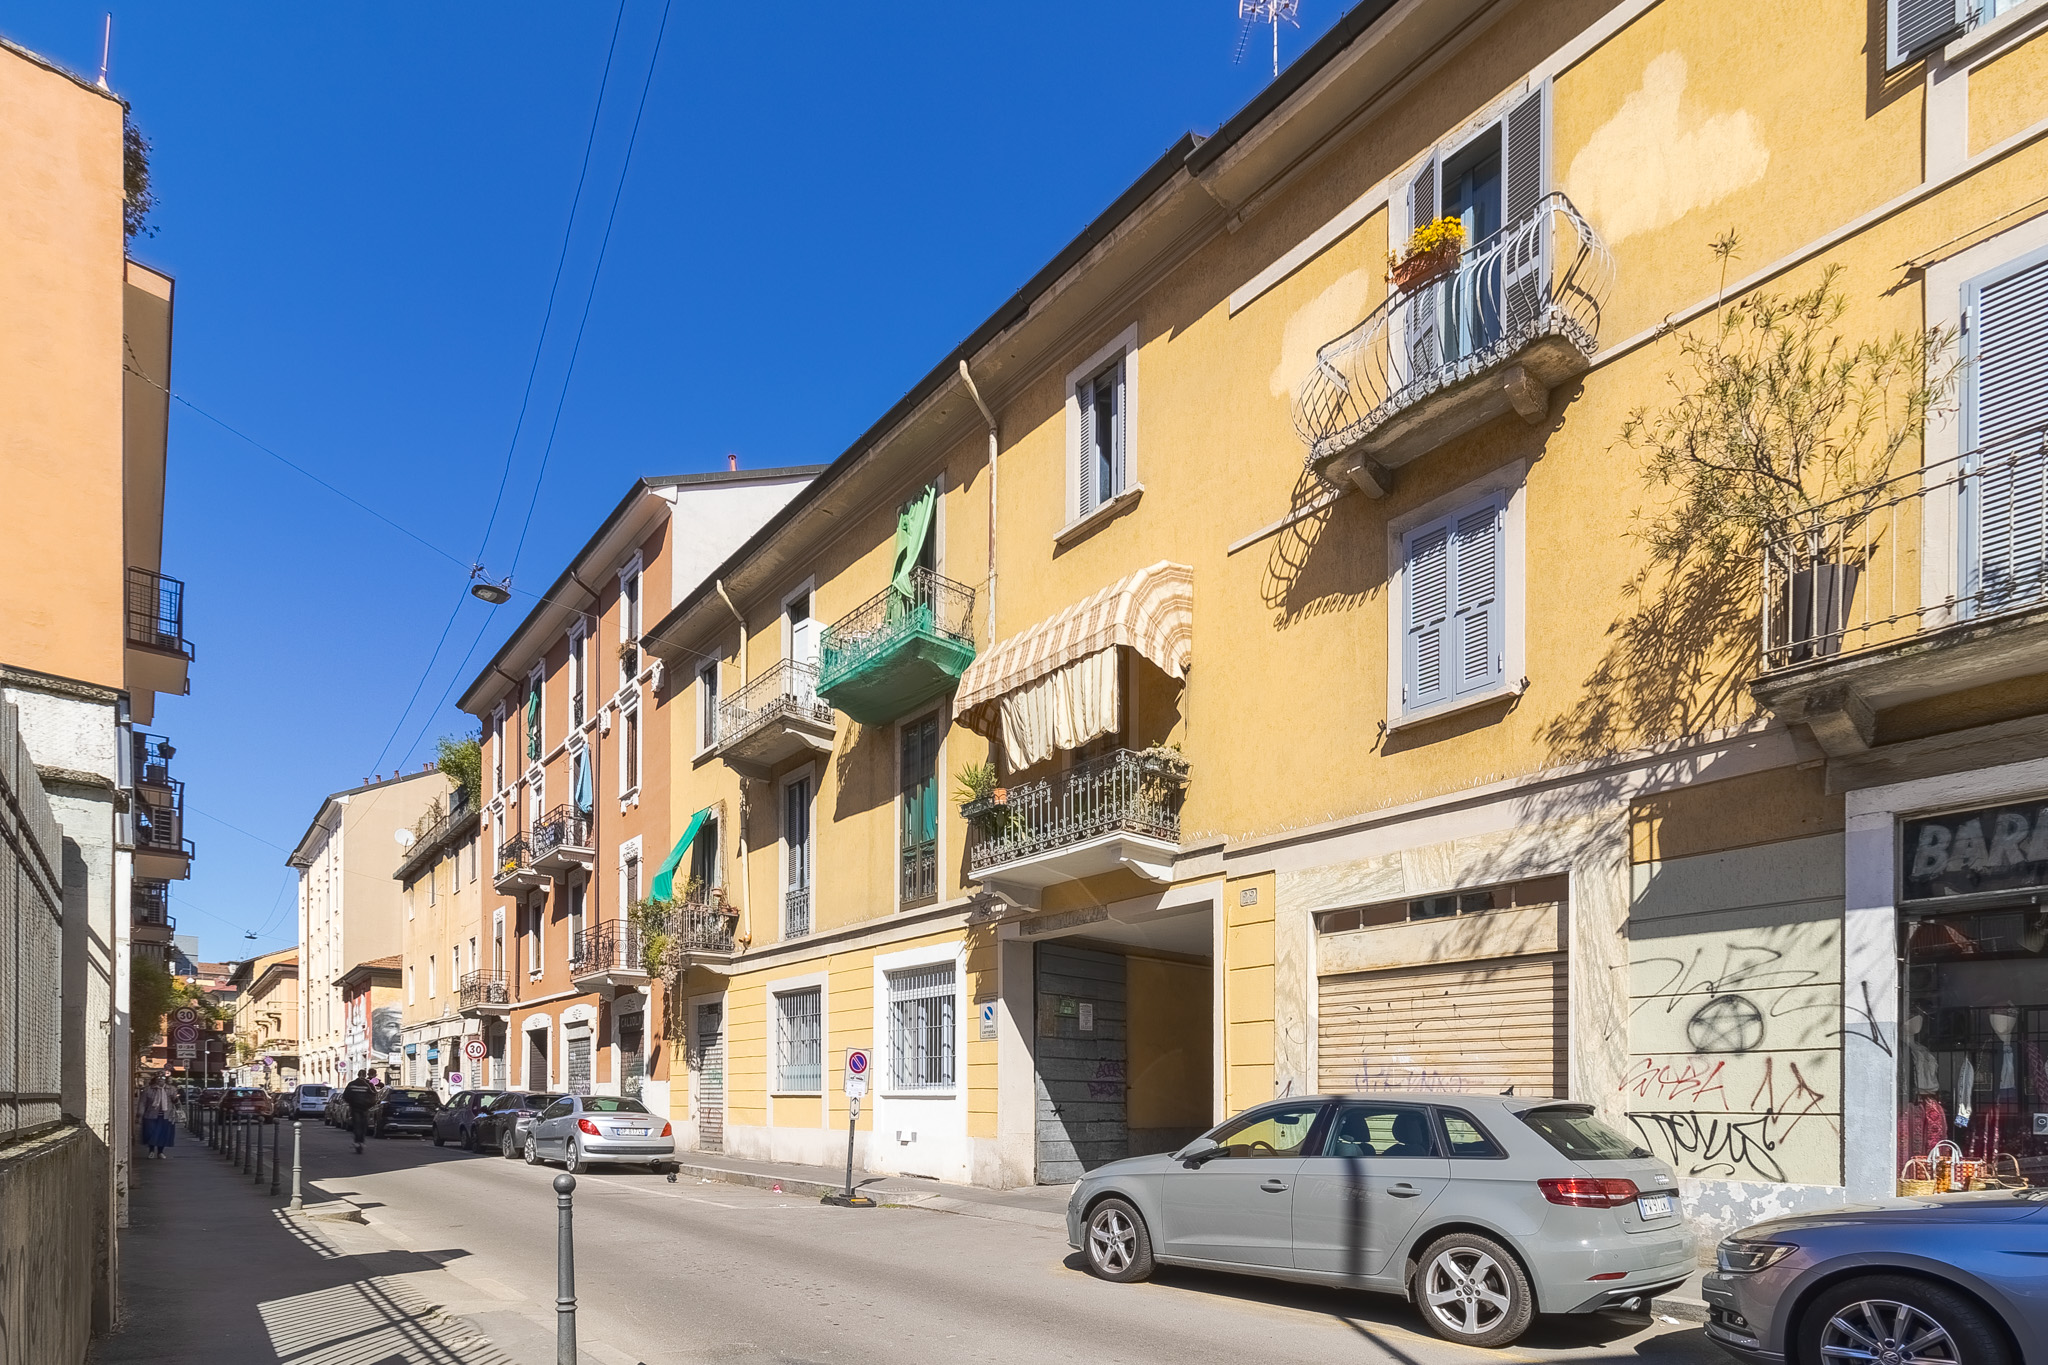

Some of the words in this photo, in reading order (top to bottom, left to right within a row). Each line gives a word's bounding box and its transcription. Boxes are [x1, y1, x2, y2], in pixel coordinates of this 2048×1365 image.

[1242, 890, 1256, 904] 22
[180, 1011, 193, 1020] 30
[469, 1045, 482, 1054] 30
